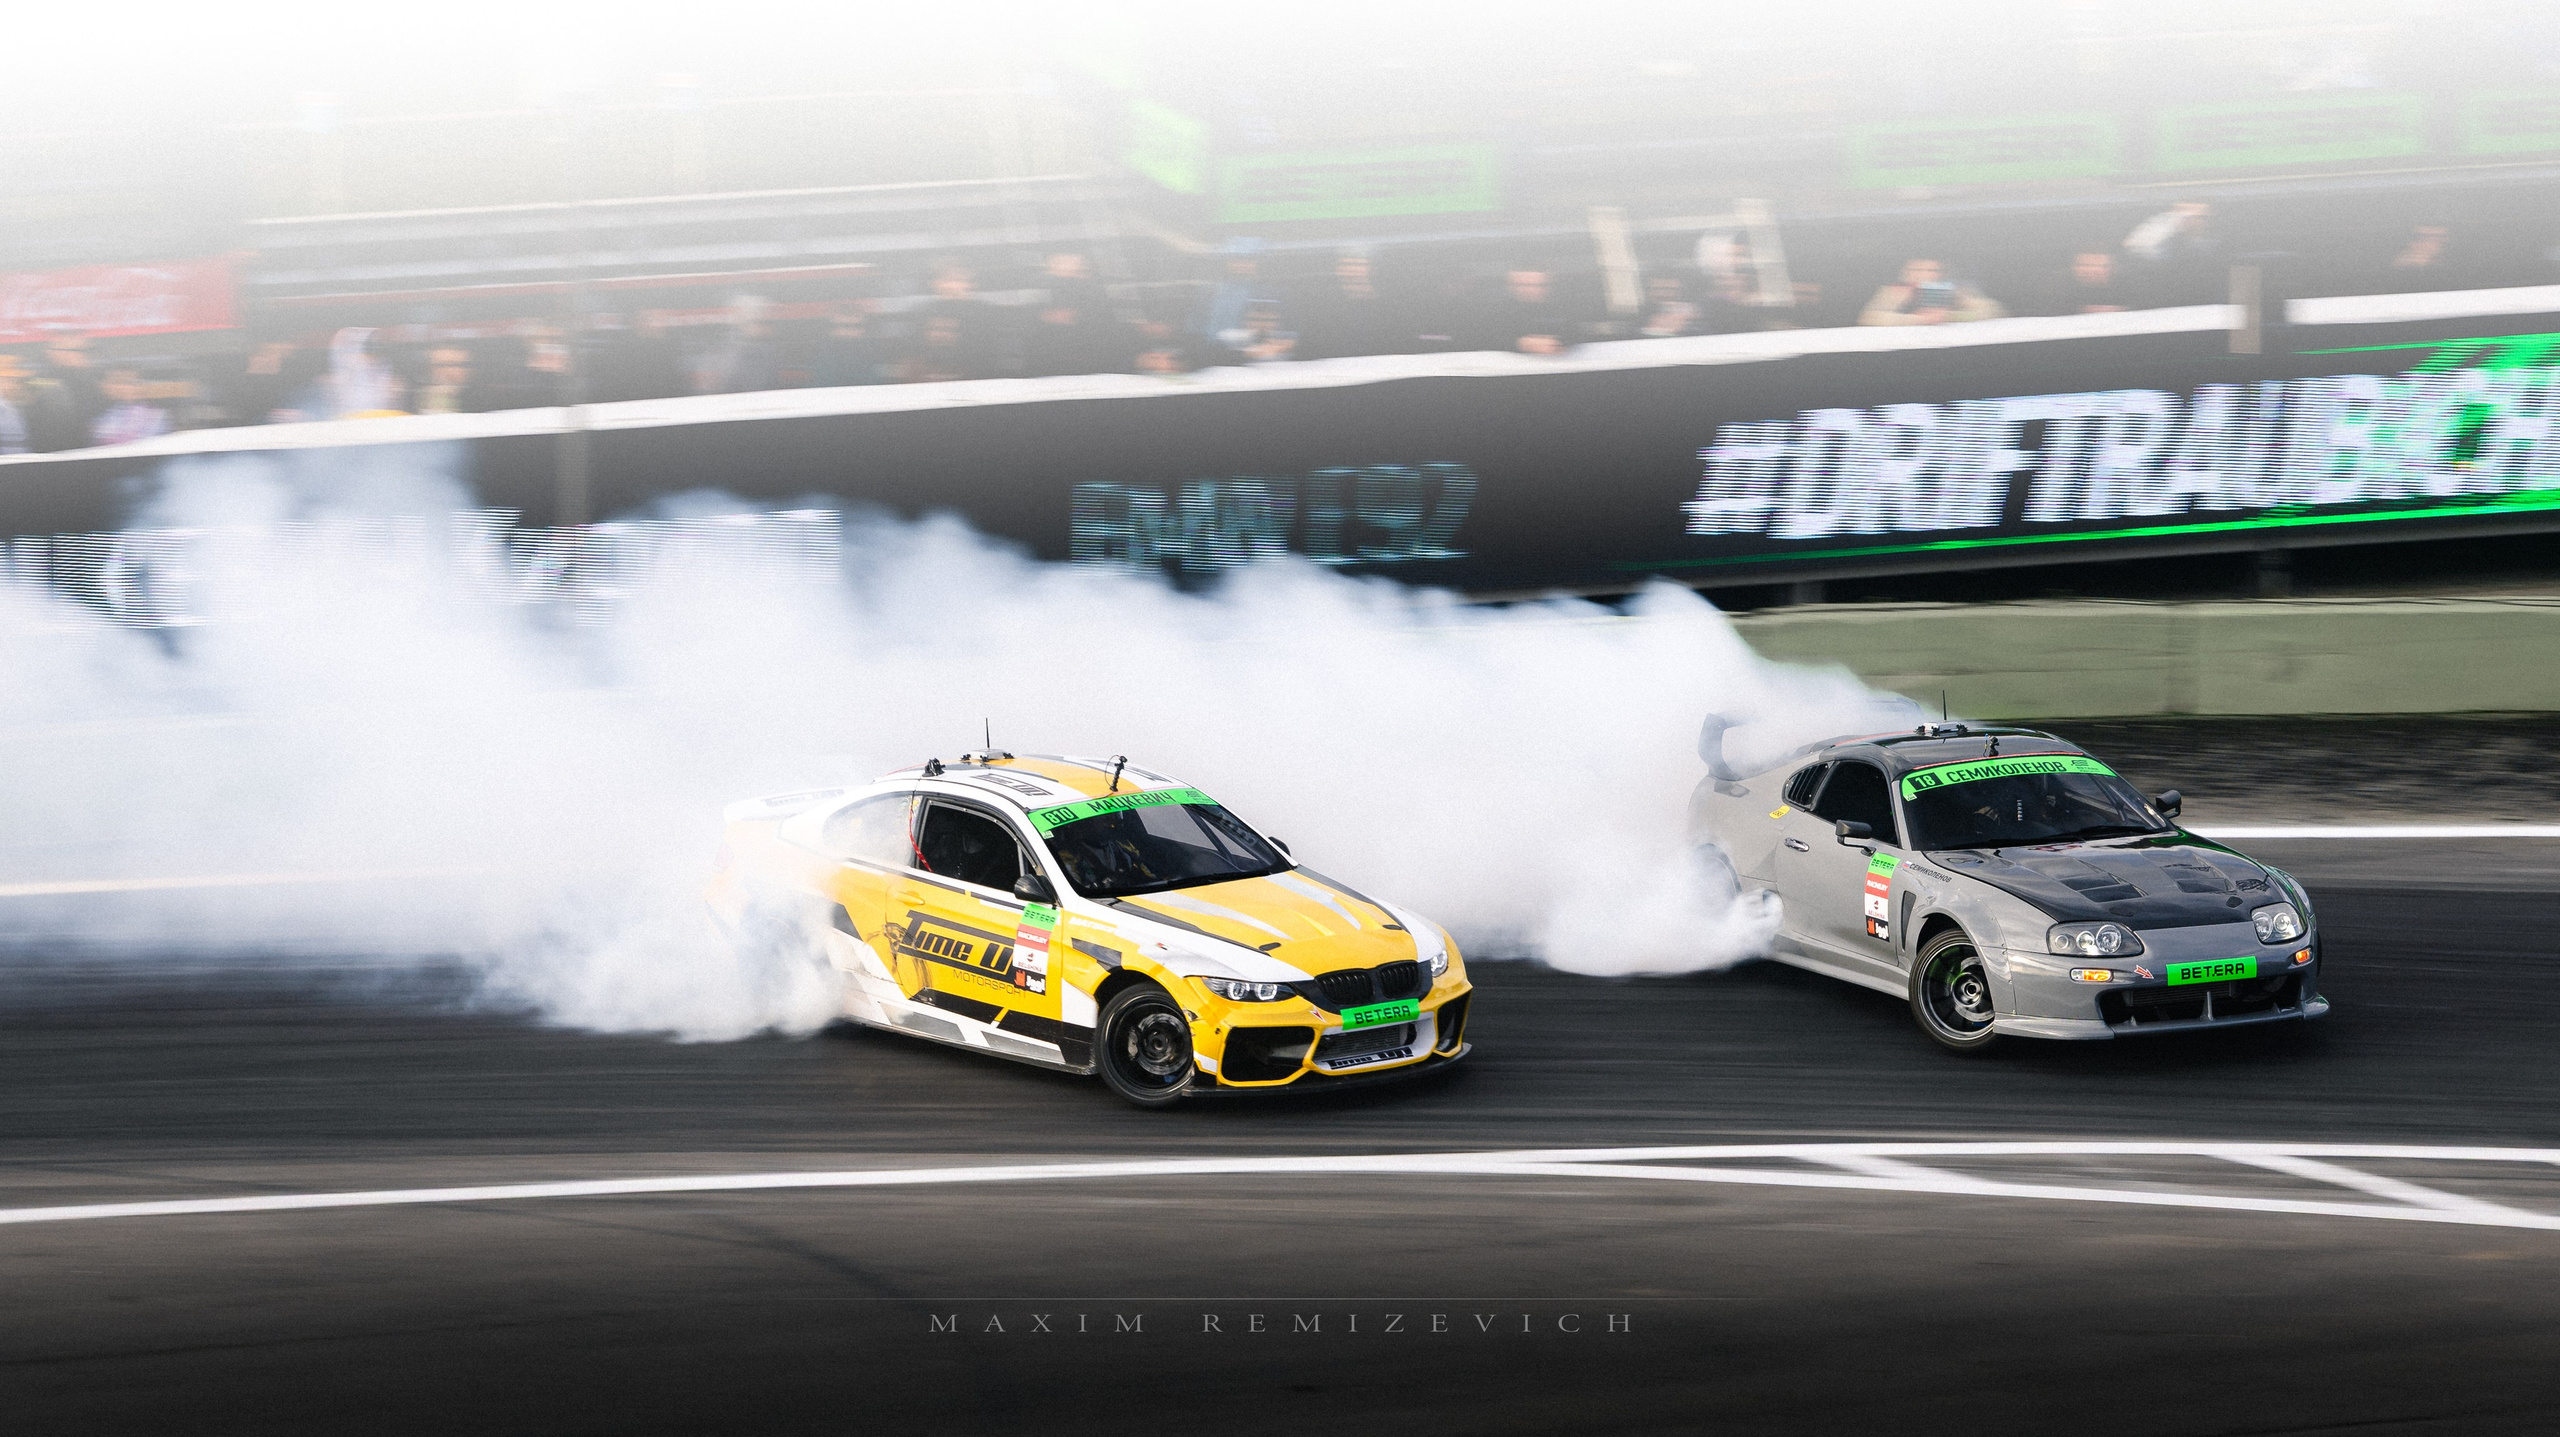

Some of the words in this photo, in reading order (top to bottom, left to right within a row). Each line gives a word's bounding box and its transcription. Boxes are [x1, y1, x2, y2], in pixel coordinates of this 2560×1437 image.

[1914, 773, 1936, 788] 18
[1946, 761, 2067, 783] СЕМИКОЛЕНОВ
[1086, 791, 1177, 814] МАЦКЕВИЧ
